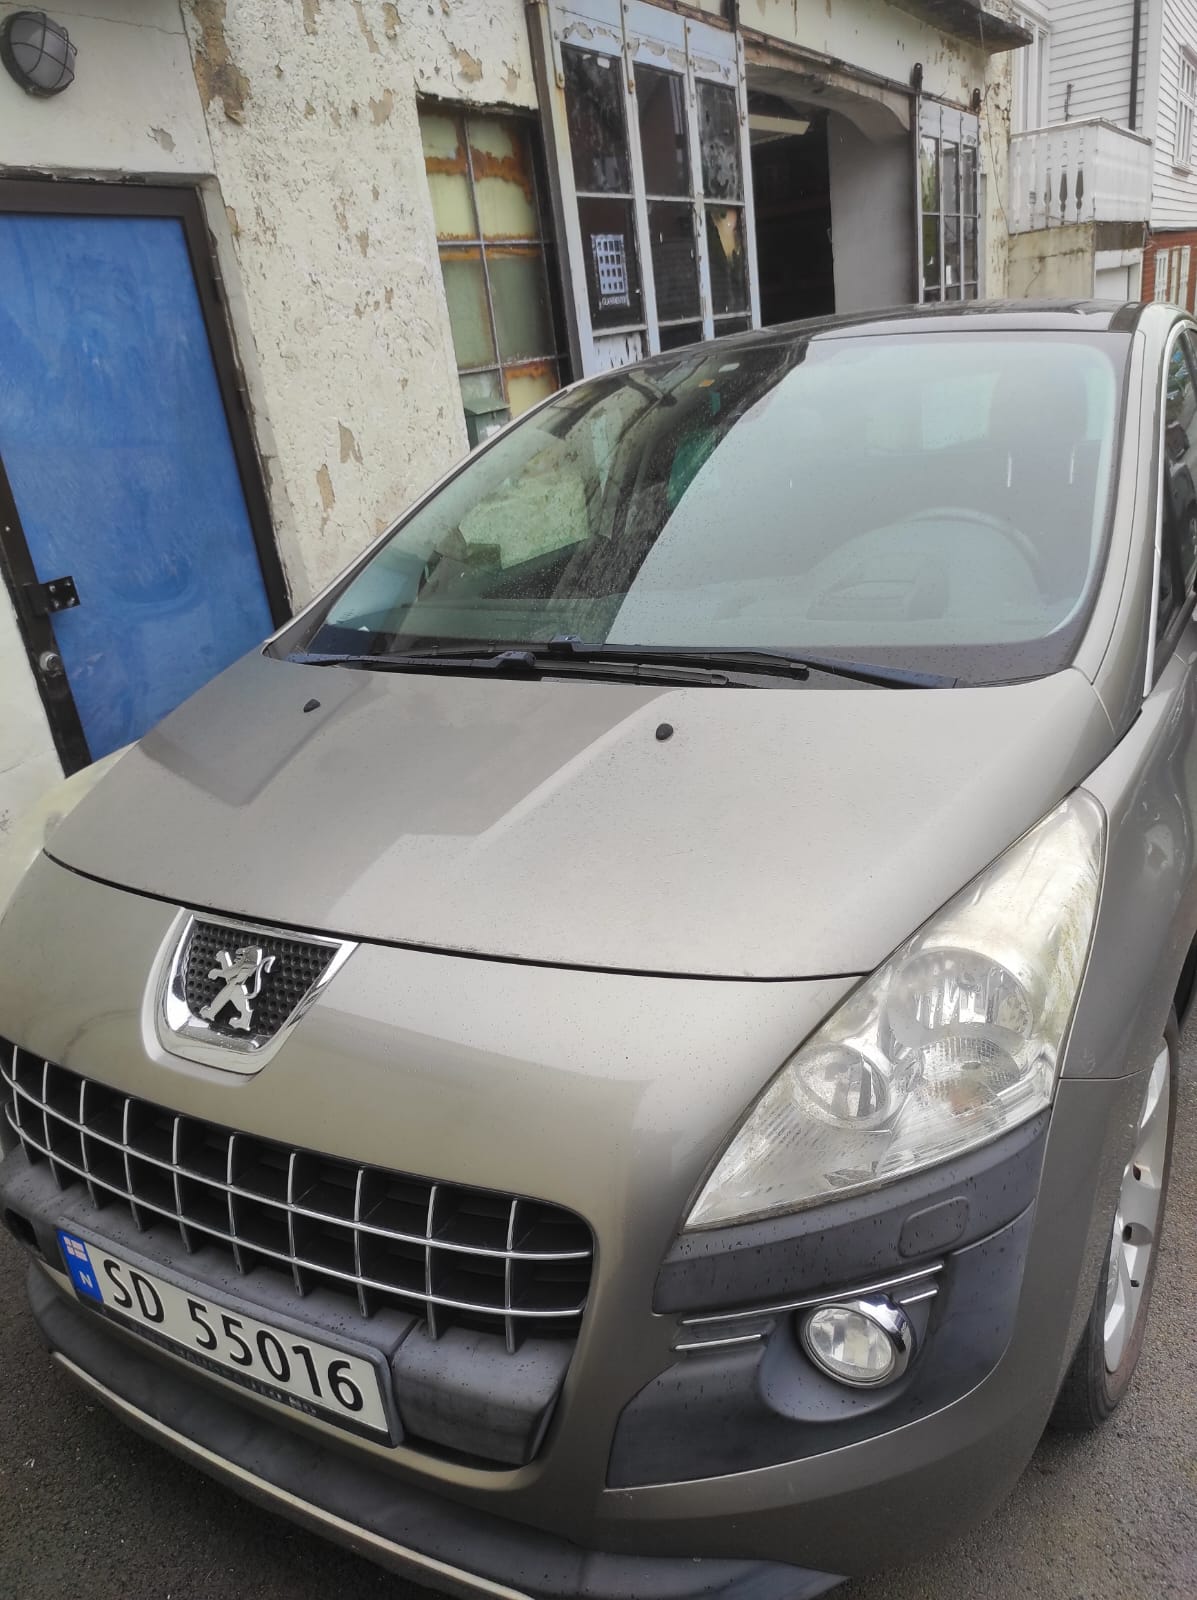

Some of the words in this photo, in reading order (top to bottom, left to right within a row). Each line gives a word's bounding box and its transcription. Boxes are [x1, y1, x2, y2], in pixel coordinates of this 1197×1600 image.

[79, 1271, 93, 1288] N
[103, 1259, 164, 1323] SD
[187, 1298, 363, 1411] 55016
